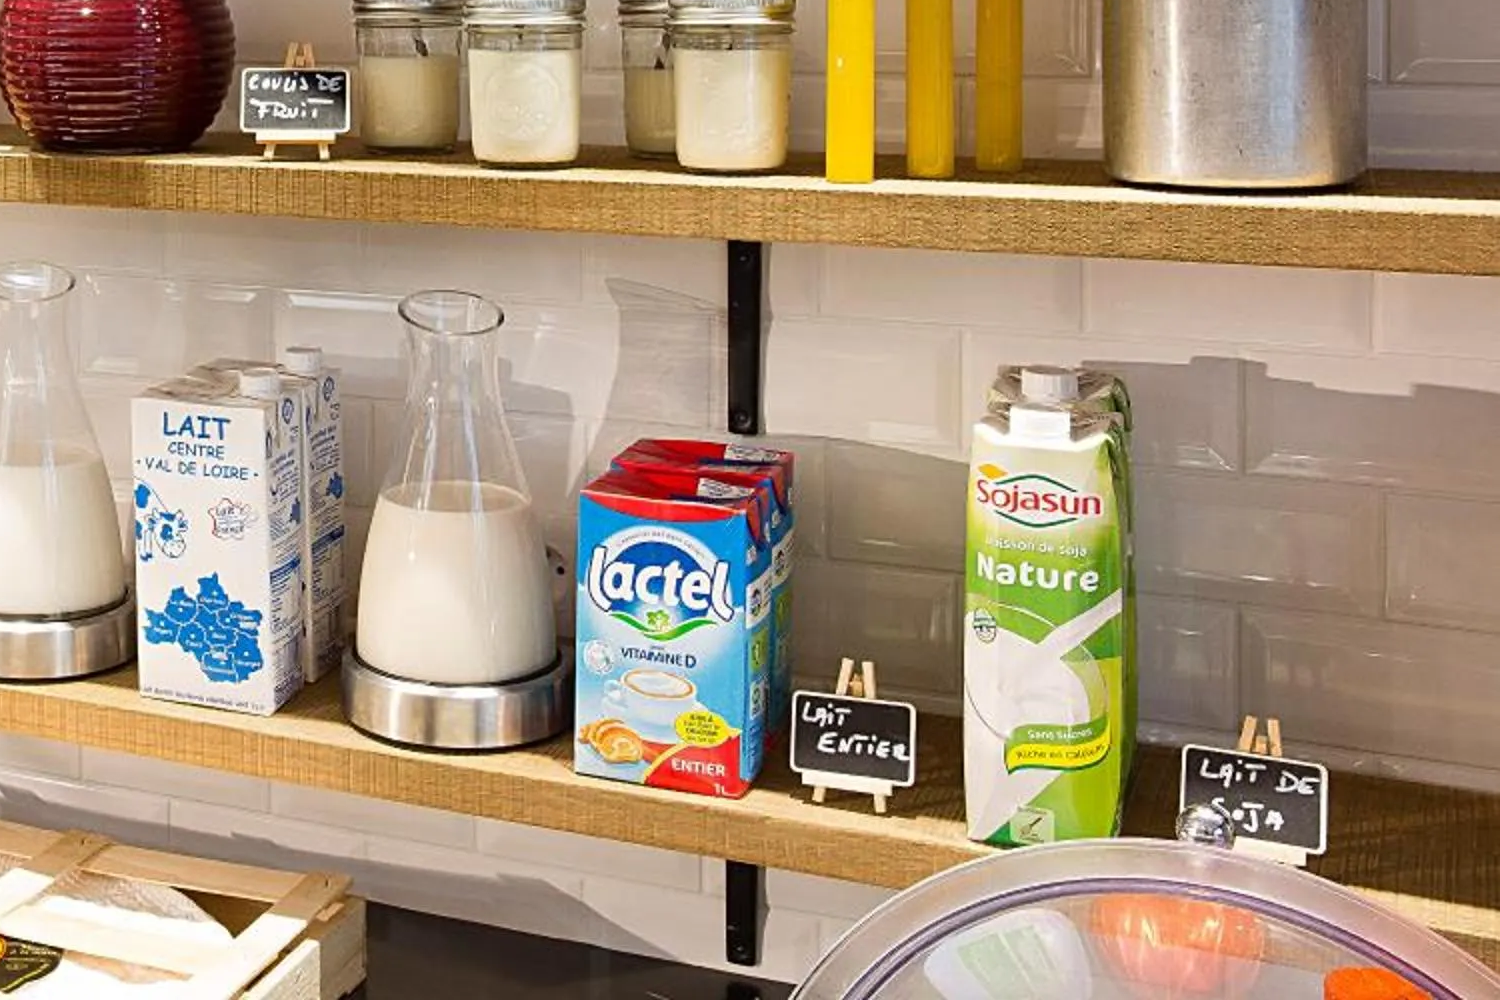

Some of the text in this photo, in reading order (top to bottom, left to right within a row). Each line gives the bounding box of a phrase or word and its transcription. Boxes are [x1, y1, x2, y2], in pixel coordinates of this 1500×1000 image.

[315, 73, 344, 92] DE
[162, 410, 232, 441] LAIT
[167, 440, 225, 462] CENTRE
[144, 457, 250, 481] VAL DE LOIRE
[976, 478, 1102, 516] Sojasun
[976, 551, 1100, 593] Nature
[621, 646, 698, 670] VITAMINE D
[671, 757, 725, 777] ENTIER
[1275, 770, 1320, 795] DE
